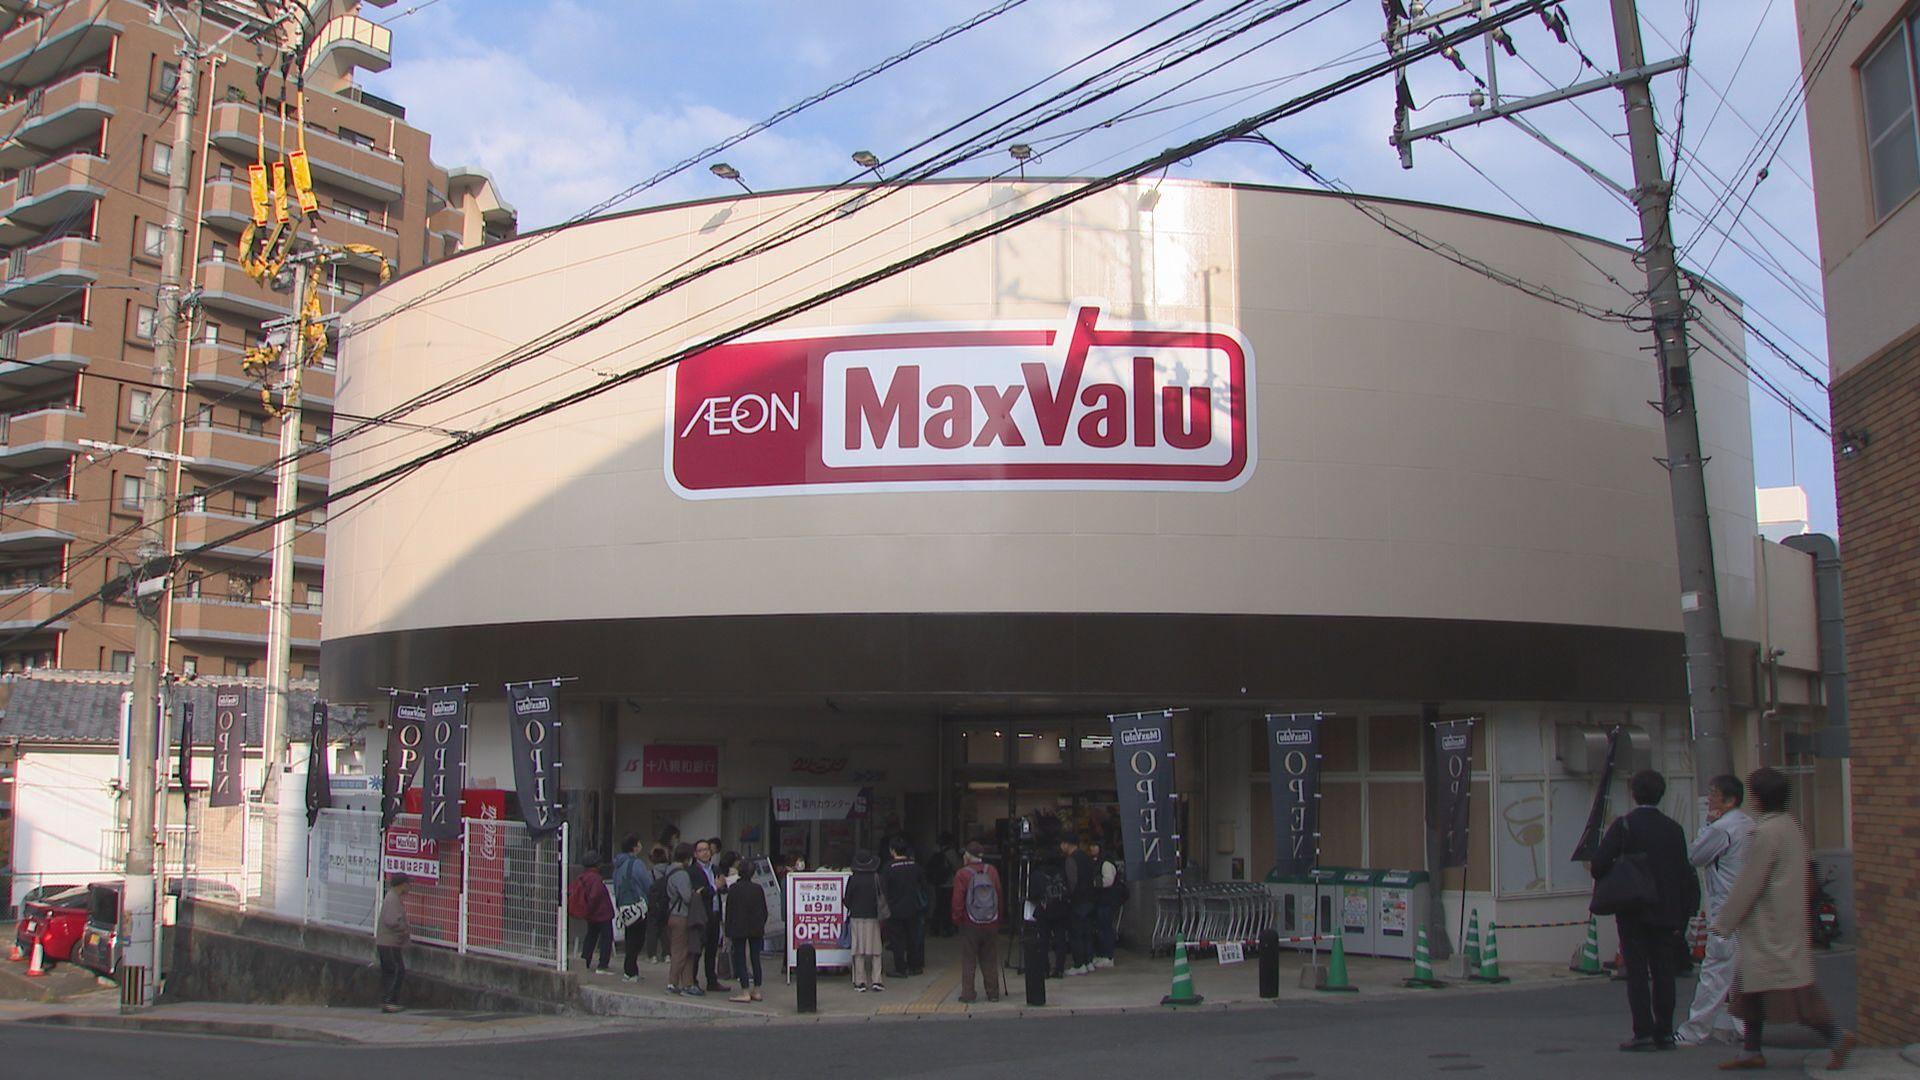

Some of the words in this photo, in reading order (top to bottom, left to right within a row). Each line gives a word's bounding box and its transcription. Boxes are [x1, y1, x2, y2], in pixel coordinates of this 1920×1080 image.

[845, 307, 1212, 451] MaxValu
[387, 857, 437, 875] 駐車場は2F屋上
[799, 915, 838, 923] リニューアル
[795, 922, 842, 940] OPEN
